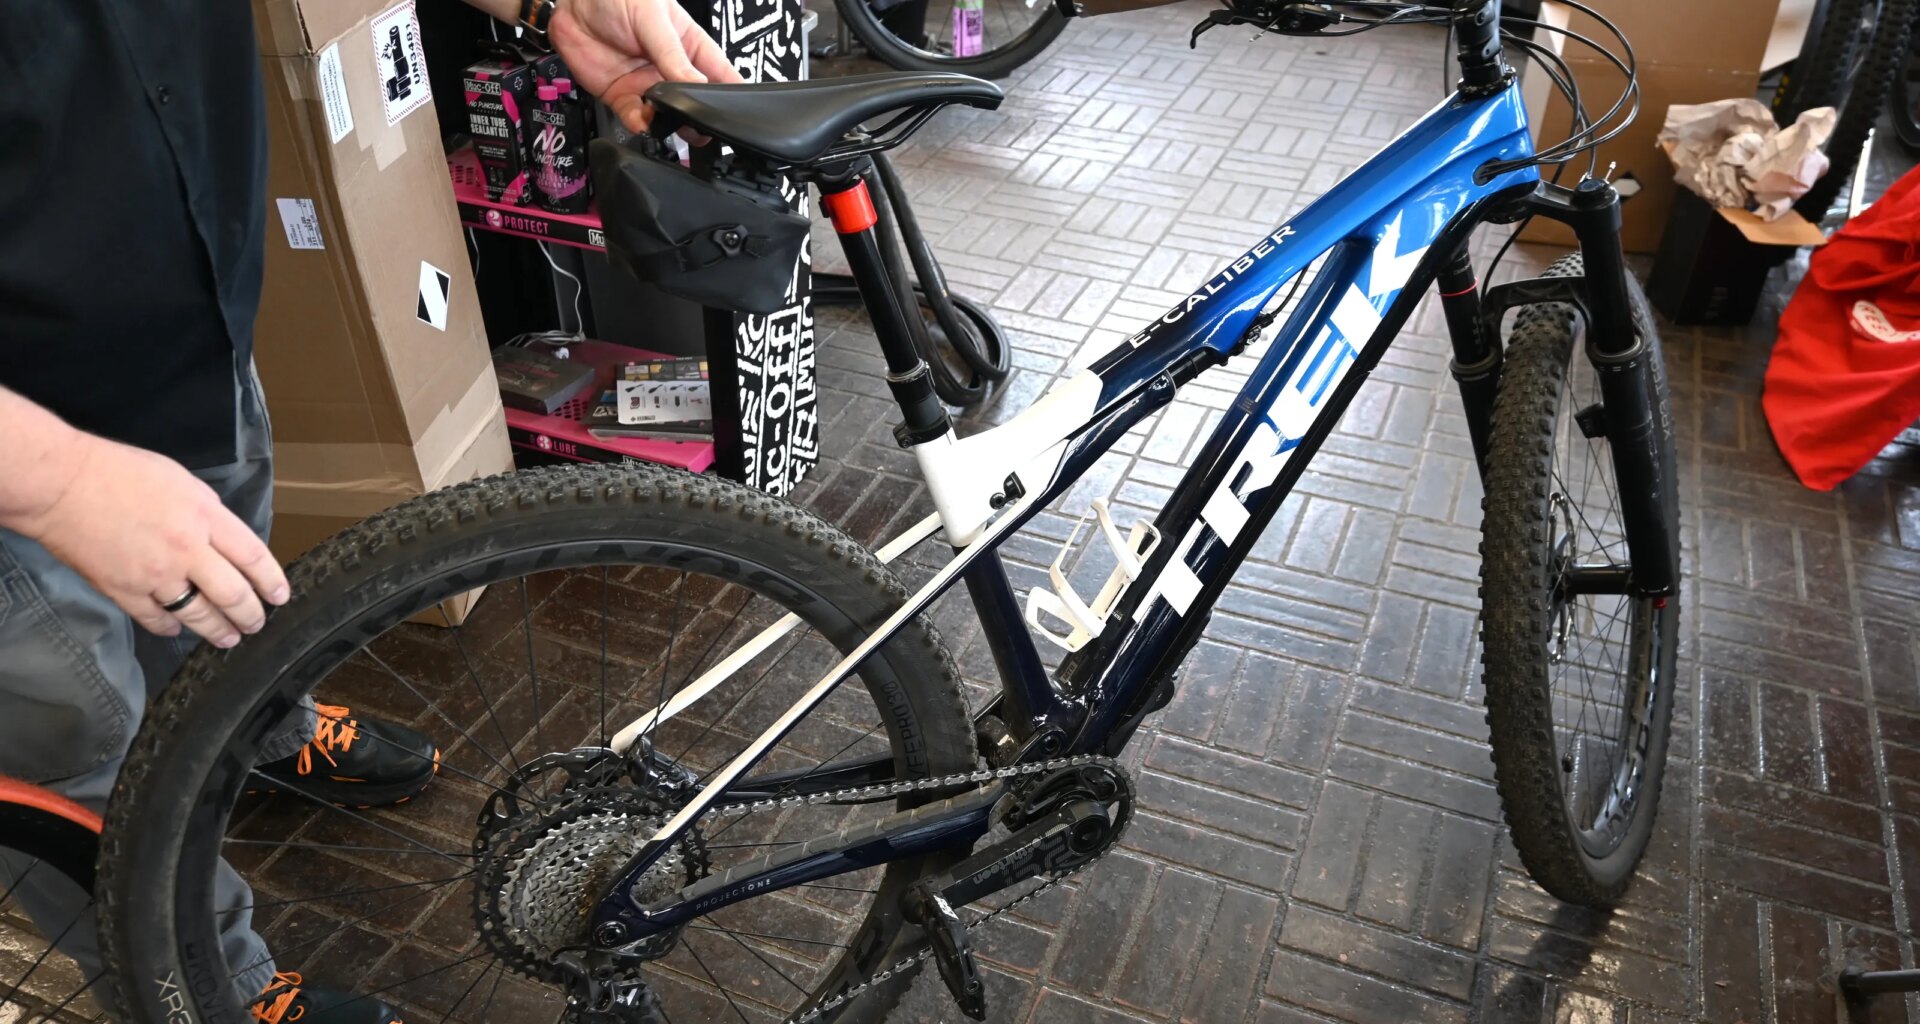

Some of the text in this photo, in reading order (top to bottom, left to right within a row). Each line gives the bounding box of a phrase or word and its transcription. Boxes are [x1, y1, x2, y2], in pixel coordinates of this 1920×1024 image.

[405, 23, 420, 85] UN3481
[504, 215, 549, 235] PROTECT
[1128, 223, 1297, 349] E-CALIBER
[1132, 208, 1431, 618] TREK
[553, 440, 577, 455] LUBE
